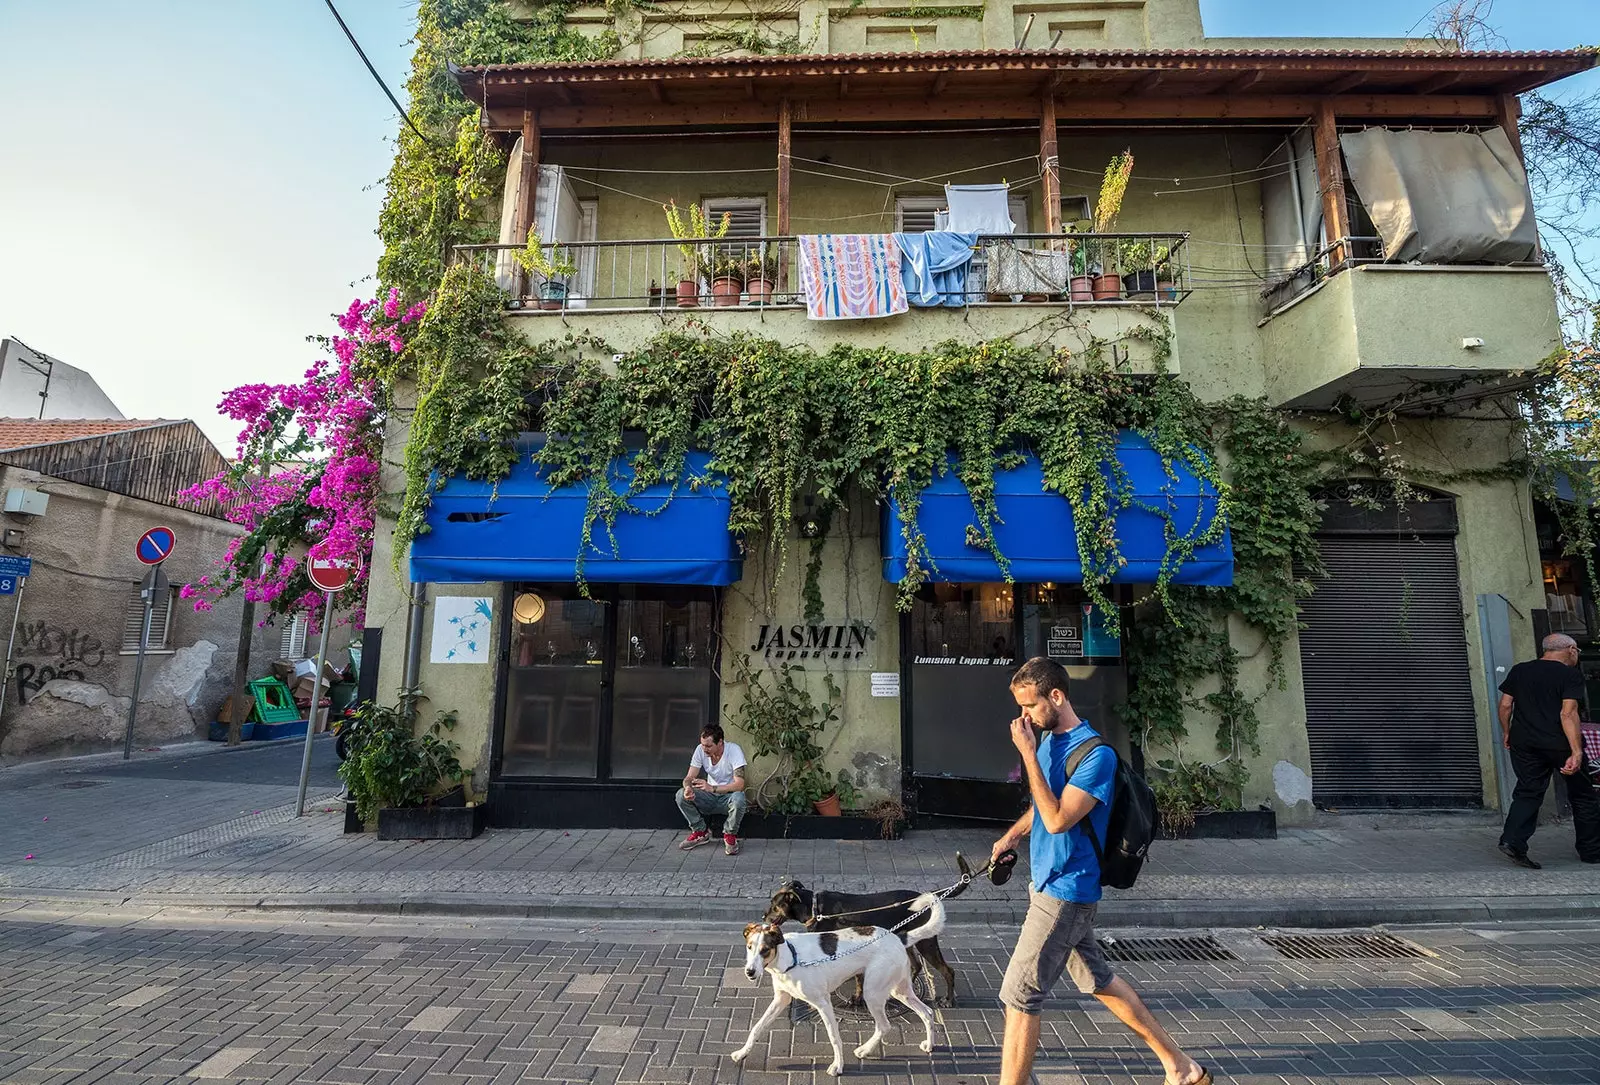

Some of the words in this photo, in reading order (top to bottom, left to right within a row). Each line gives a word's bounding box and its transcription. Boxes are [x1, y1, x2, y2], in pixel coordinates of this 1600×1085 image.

[1, 579, 11, 590] 8
[751, 624, 869, 652] JASMIN
[764, 648, 821, 660] tapas
